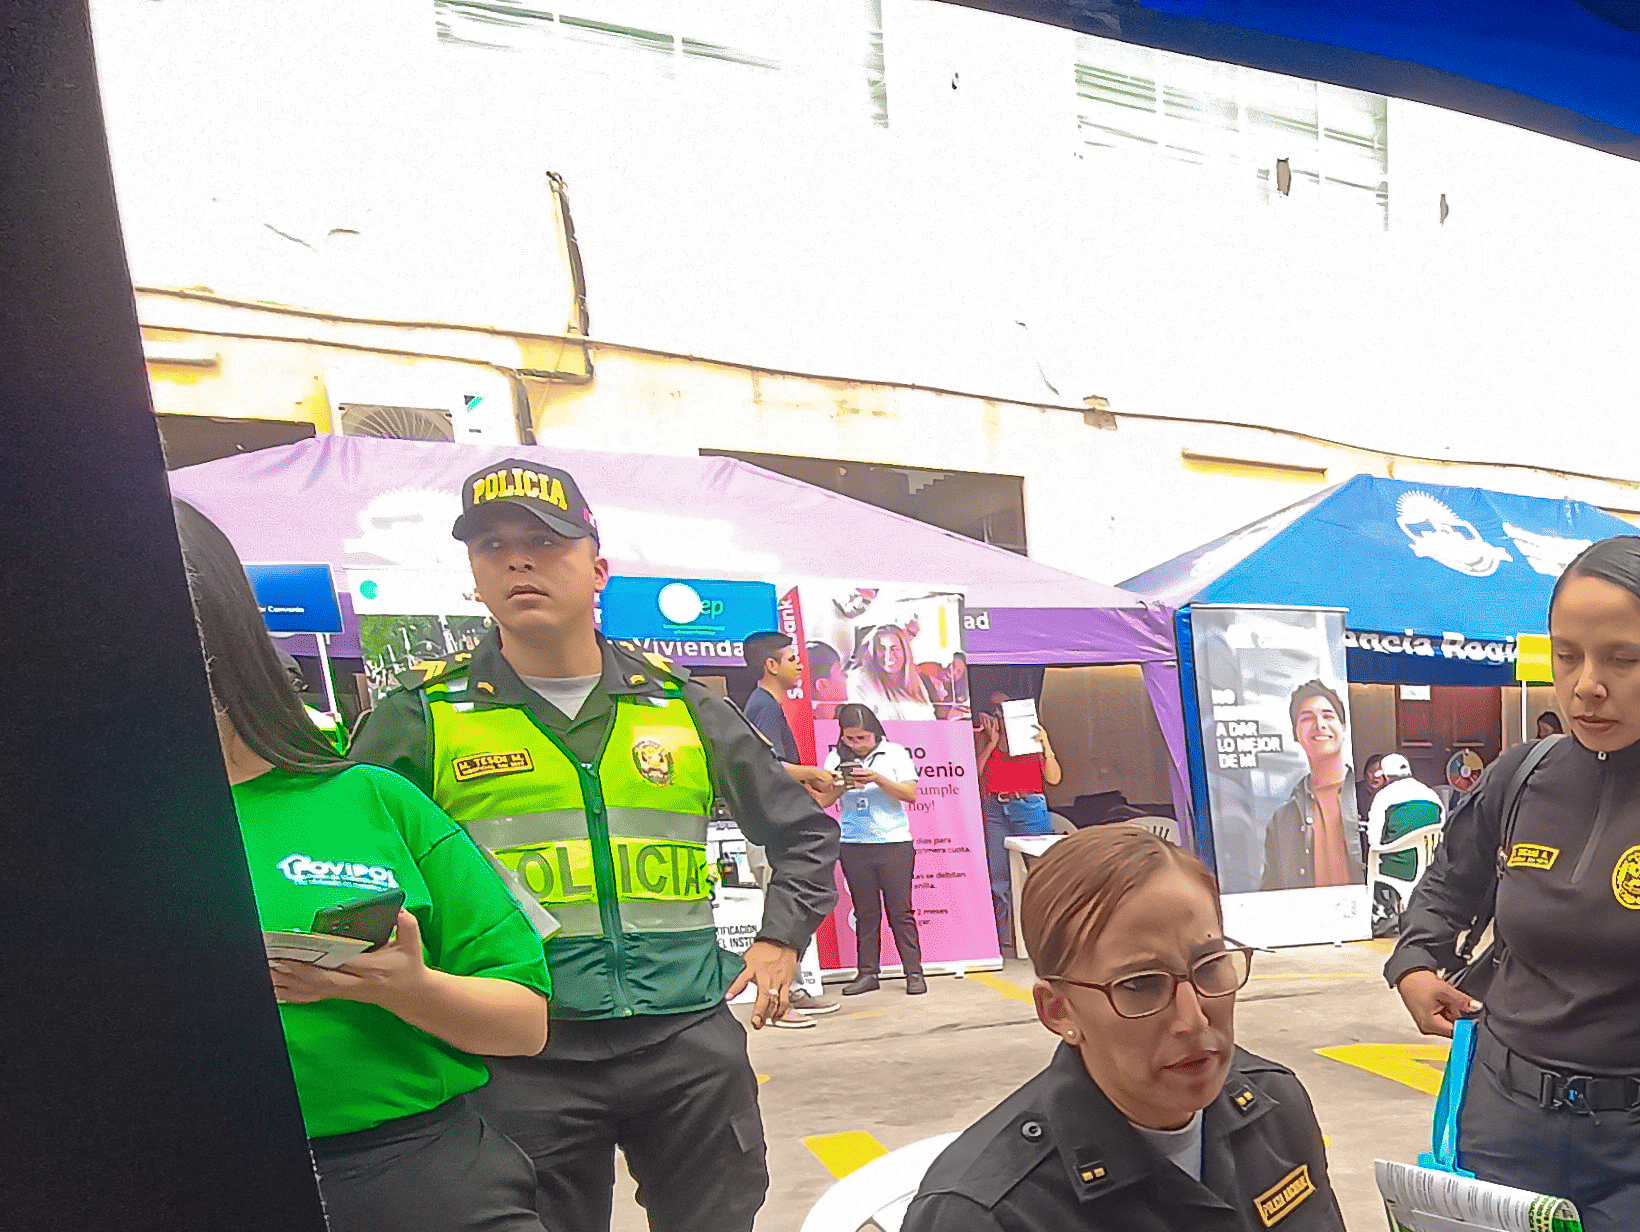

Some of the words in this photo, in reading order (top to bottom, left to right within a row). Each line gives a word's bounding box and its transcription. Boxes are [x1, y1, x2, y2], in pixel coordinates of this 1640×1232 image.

[473, 467, 568, 511] POLICIA
[1215, 721, 1228, 736] A
[1216, 737, 1236, 753] LO
[1236, 736, 1283, 753] MEJOR
[1218, 753, 1239, 769] DE
[916, 762, 965, 778] venio
[517, 844, 702, 900] OLICIA
